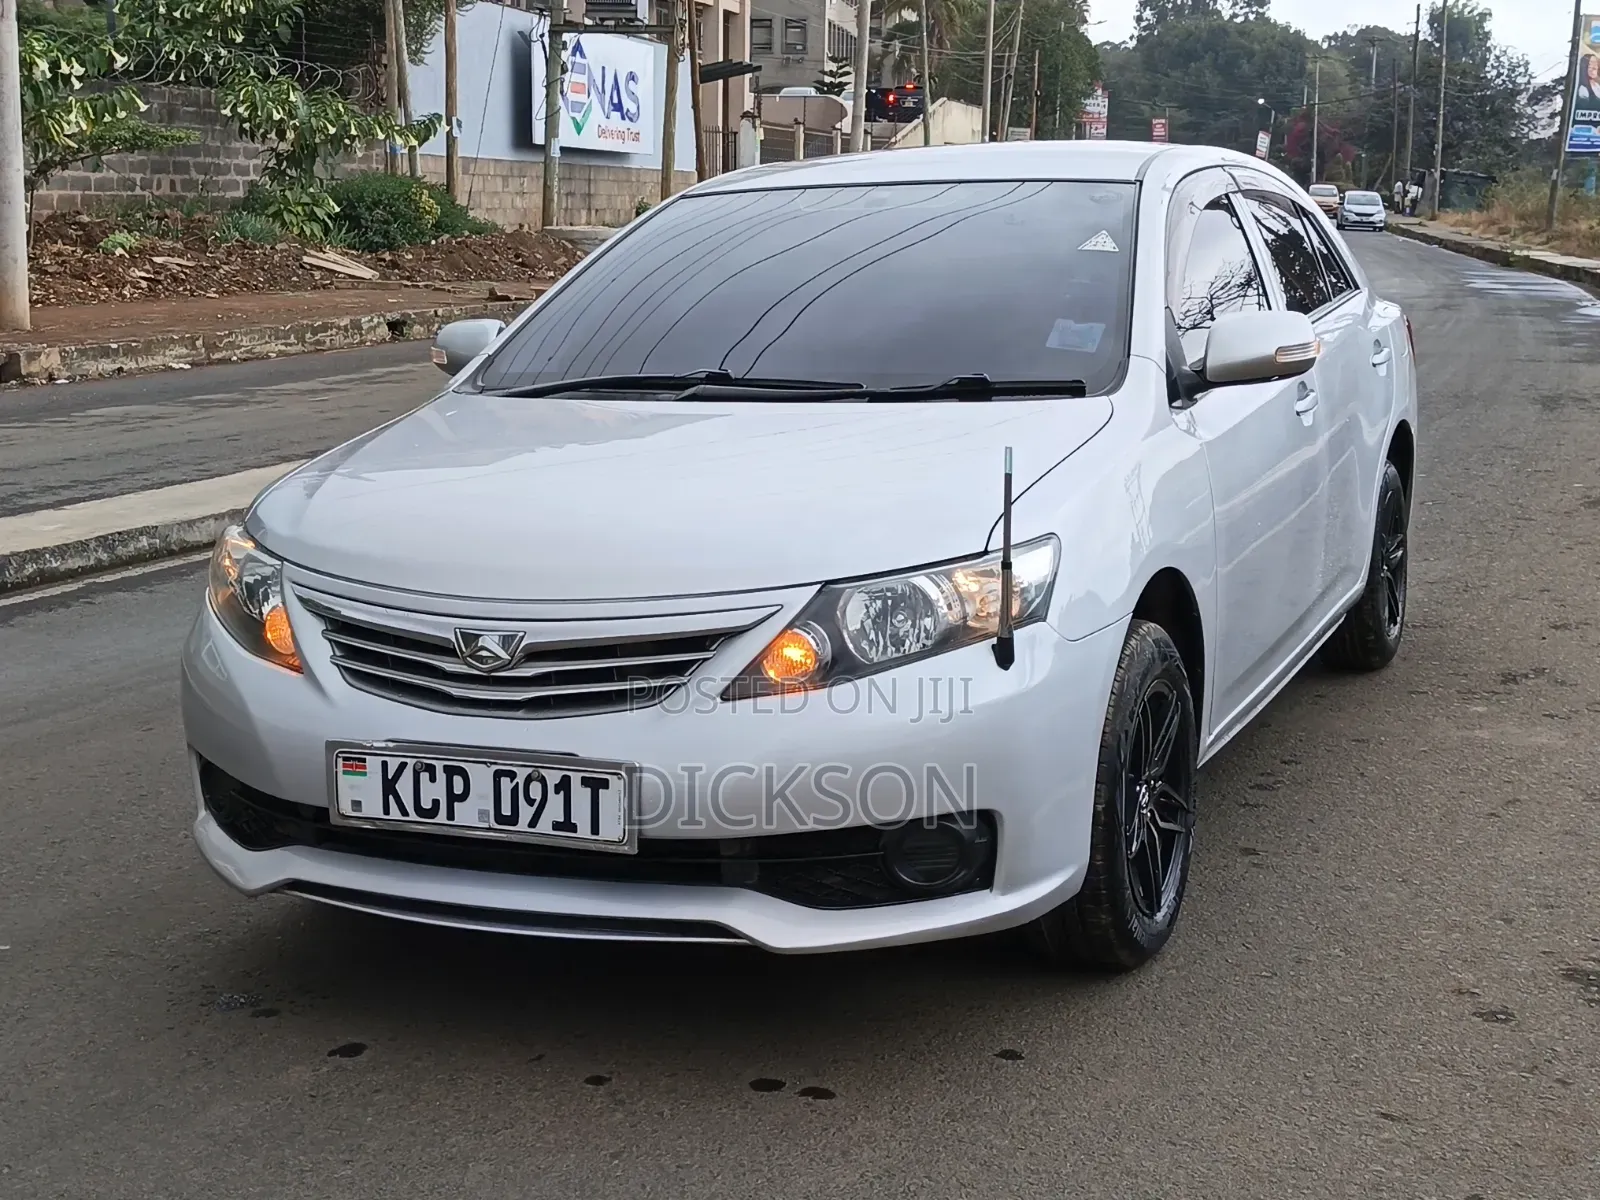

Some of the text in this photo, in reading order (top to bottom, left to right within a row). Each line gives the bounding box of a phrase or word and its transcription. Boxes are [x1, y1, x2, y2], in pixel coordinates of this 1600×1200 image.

[1576, 110, 1600, 120] IMPR
[597, 124, 641, 144] Delivering Trust
[380, 759, 471, 822] KCP
[493, 768, 610, 836] 091T
